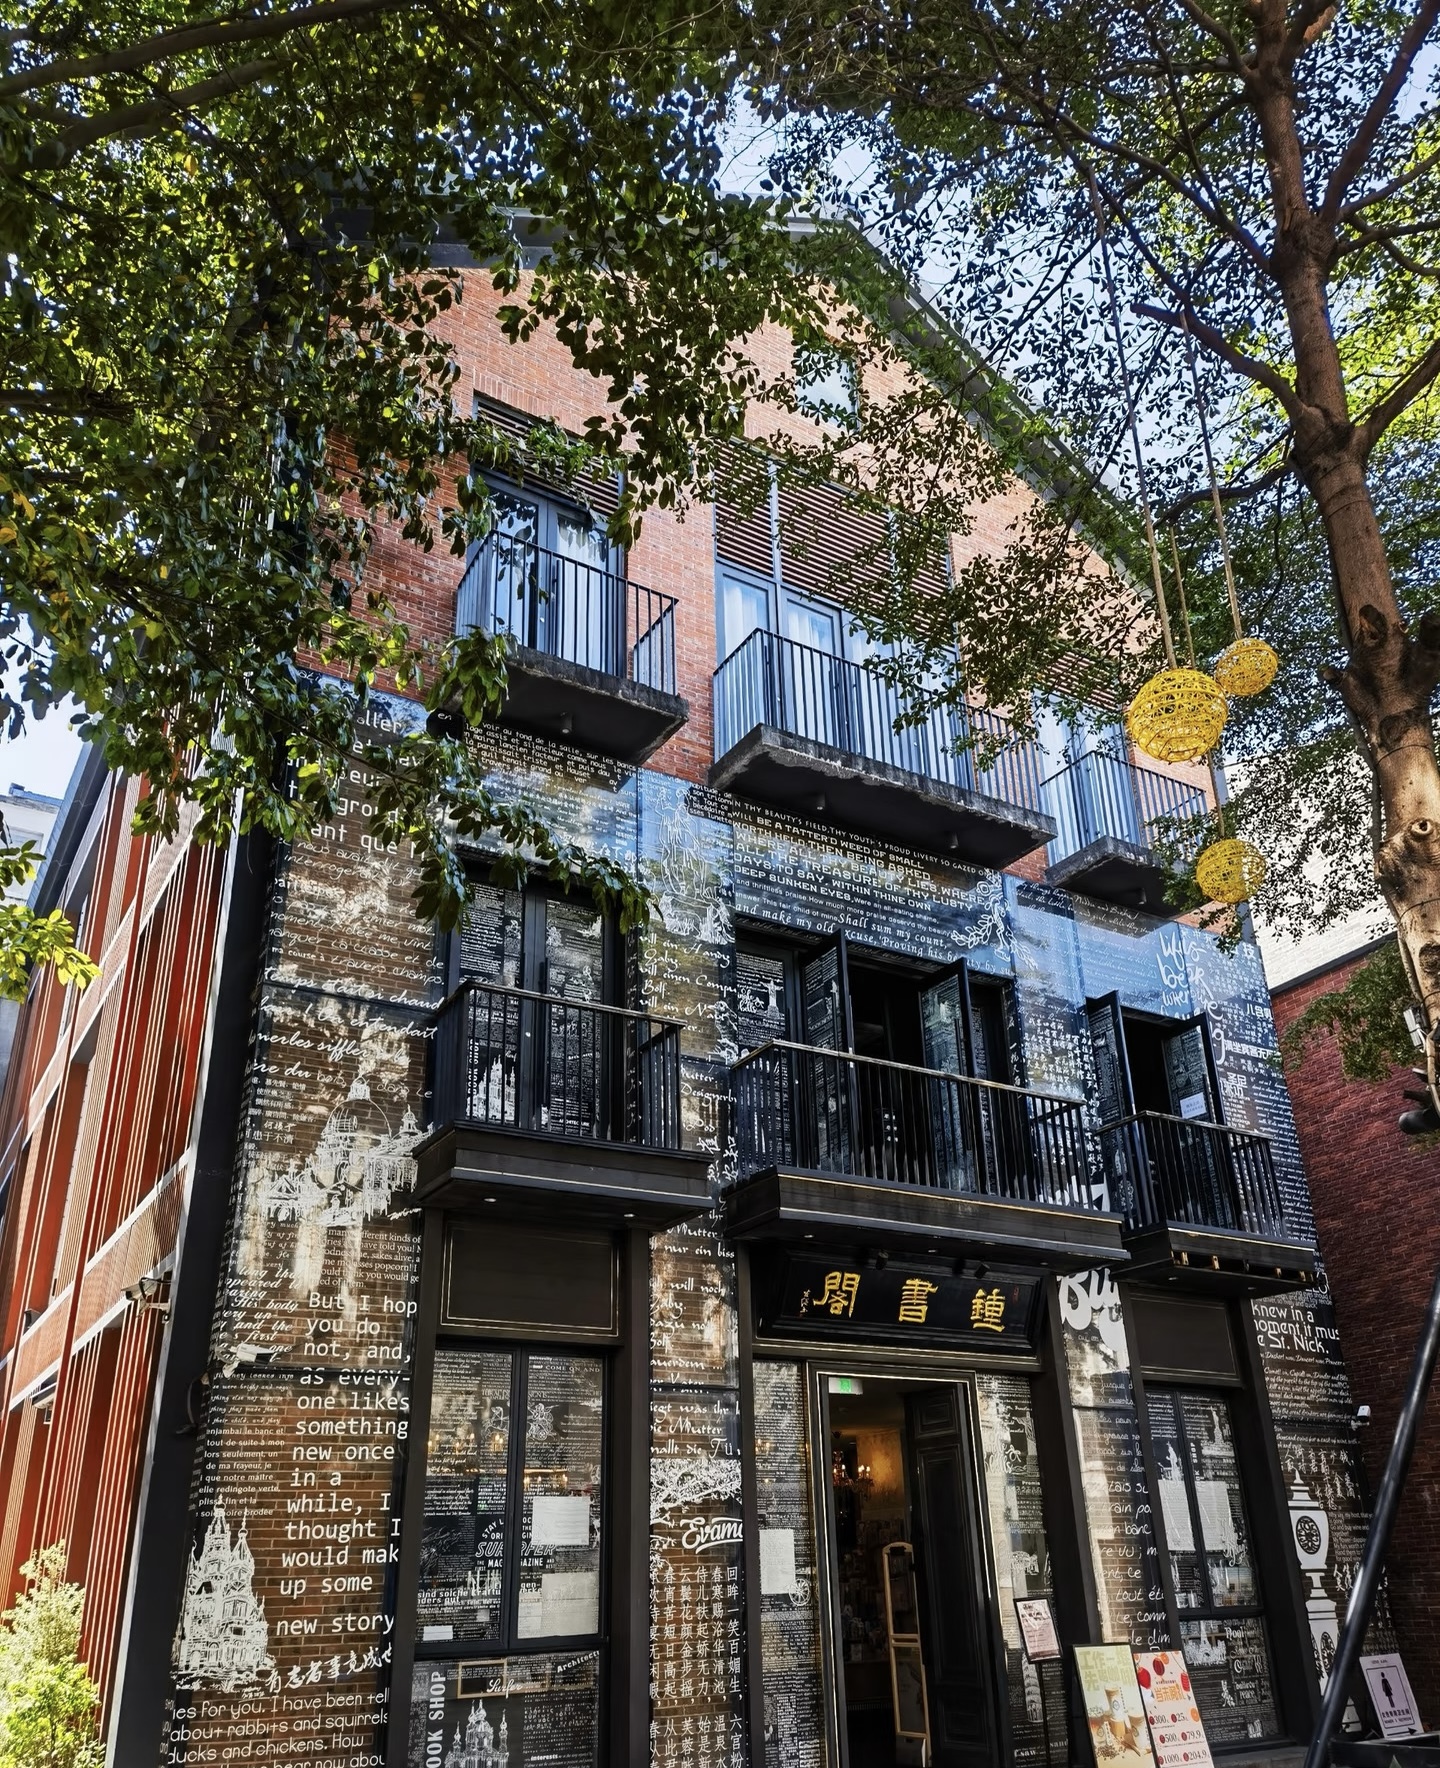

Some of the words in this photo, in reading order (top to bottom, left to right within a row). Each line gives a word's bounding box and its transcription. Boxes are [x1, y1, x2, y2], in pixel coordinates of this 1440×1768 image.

[744, 803, 762, 813] THY
[884, 843, 911, 855] PROUD
[913, 851, 938, 863] LIVERY
[940, 859, 950, 867] SO
[952, 862, 976, 874] GAZED
[757, 816, 772, 827] BE
[840, 839, 871, 854] WEED
[872, 849, 887, 858] OF
[889, 854, 925, 869] SMALL
[735, 830, 787, 852] WHERE
[789, 846, 817, 860] ALL
[820, 853, 847, 868] THY
[850, 861, 906, 884] BEAUTY
[846, 849, 885, 869] BEING
[734, 864, 766, 878] DEEP
[769, 873, 818, 893] SUNKEN
[736, 842, 765, 857] ALL
[768, 850, 799, 867] THE
[884, 881, 902, 892] OF
[904, 886, 930, 900] THY
[932, 893, 974, 912] LUSTY
[831, 879, 871, 896] WITHIN
[873, 889, 906, 905] THINE
[908, 899, 932, 912] OWN
[735, 901, 760, 915] and
[796, 917, 812, 930] my
[816, 921, 836, 934] old
[838, 913, 868, 928] Shall
[871, 923, 892, 935] sum
[896, 928, 911, 942] my
[389, 1232, 411, 1243] kinds
[309, 1292, 345, 1309] But
[360, 1295, 371, 1311] I
[383, 1296, 418, 1318] hop
[1250, 1299, 1288, 1319] knew
[1290, 1305, 1304, 1322] in
[1306, 1311, 1315, 1323] a
[305, 1319, 343, 1336] you
[357, 1317, 381, 1335] do
[1303, 1322, 1312, 1337] it
[303, 1340, 351, 1361] not,
[367, 1342, 411, 1363] and,
[1267, 1330, 1291, 1350] St.
[1293, 1334, 1330, 1354] Nick.
[300, 1366, 326, 1385] as
[297, 1395, 336, 1410] one
[349, 1392, 410, 1411] likes
[295, 1416, 409, 1440] something
[292, 1446, 333, 1461] new
[344, 1445, 395, 1460] once
[290, 1467, 316, 1487] in
[329, 1472, 342, 1486] a
[287, 1493, 362, 1515] while,
[284, 1518, 377, 1543] thought
[390, 1518, 401, 1537] I
[482, 1521, 497, 1538] STAY
[282, 1545, 349, 1567] would
[361, 1543, 399, 1564] mak
[279, 1579, 307, 1600] up
[321, 1575, 373, 1593] some
[276, 1618, 318, 1636] new
[331, 1613, 395, 1635] story
[201, 1701, 226, 1717] for
[231, 1701, 266, 1720] you.
[270, 1695, 279, 1712] I
[282, 1695, 322, 1712] have
[326, 1692, 363, 1708] been
[428, 1671, 447, 1721] SHOP
[170, 1724, 223, 1742] about
[227, 1718, 289, 1737] rabbits
[292, 1714, 322, 1731] and
[167, 1745, 217, 1765] ducks
[222, 1742, 251, 1759] and
[255, 1736, 328, 1756] chickens.
[332, 1732, 365, 1749] How
